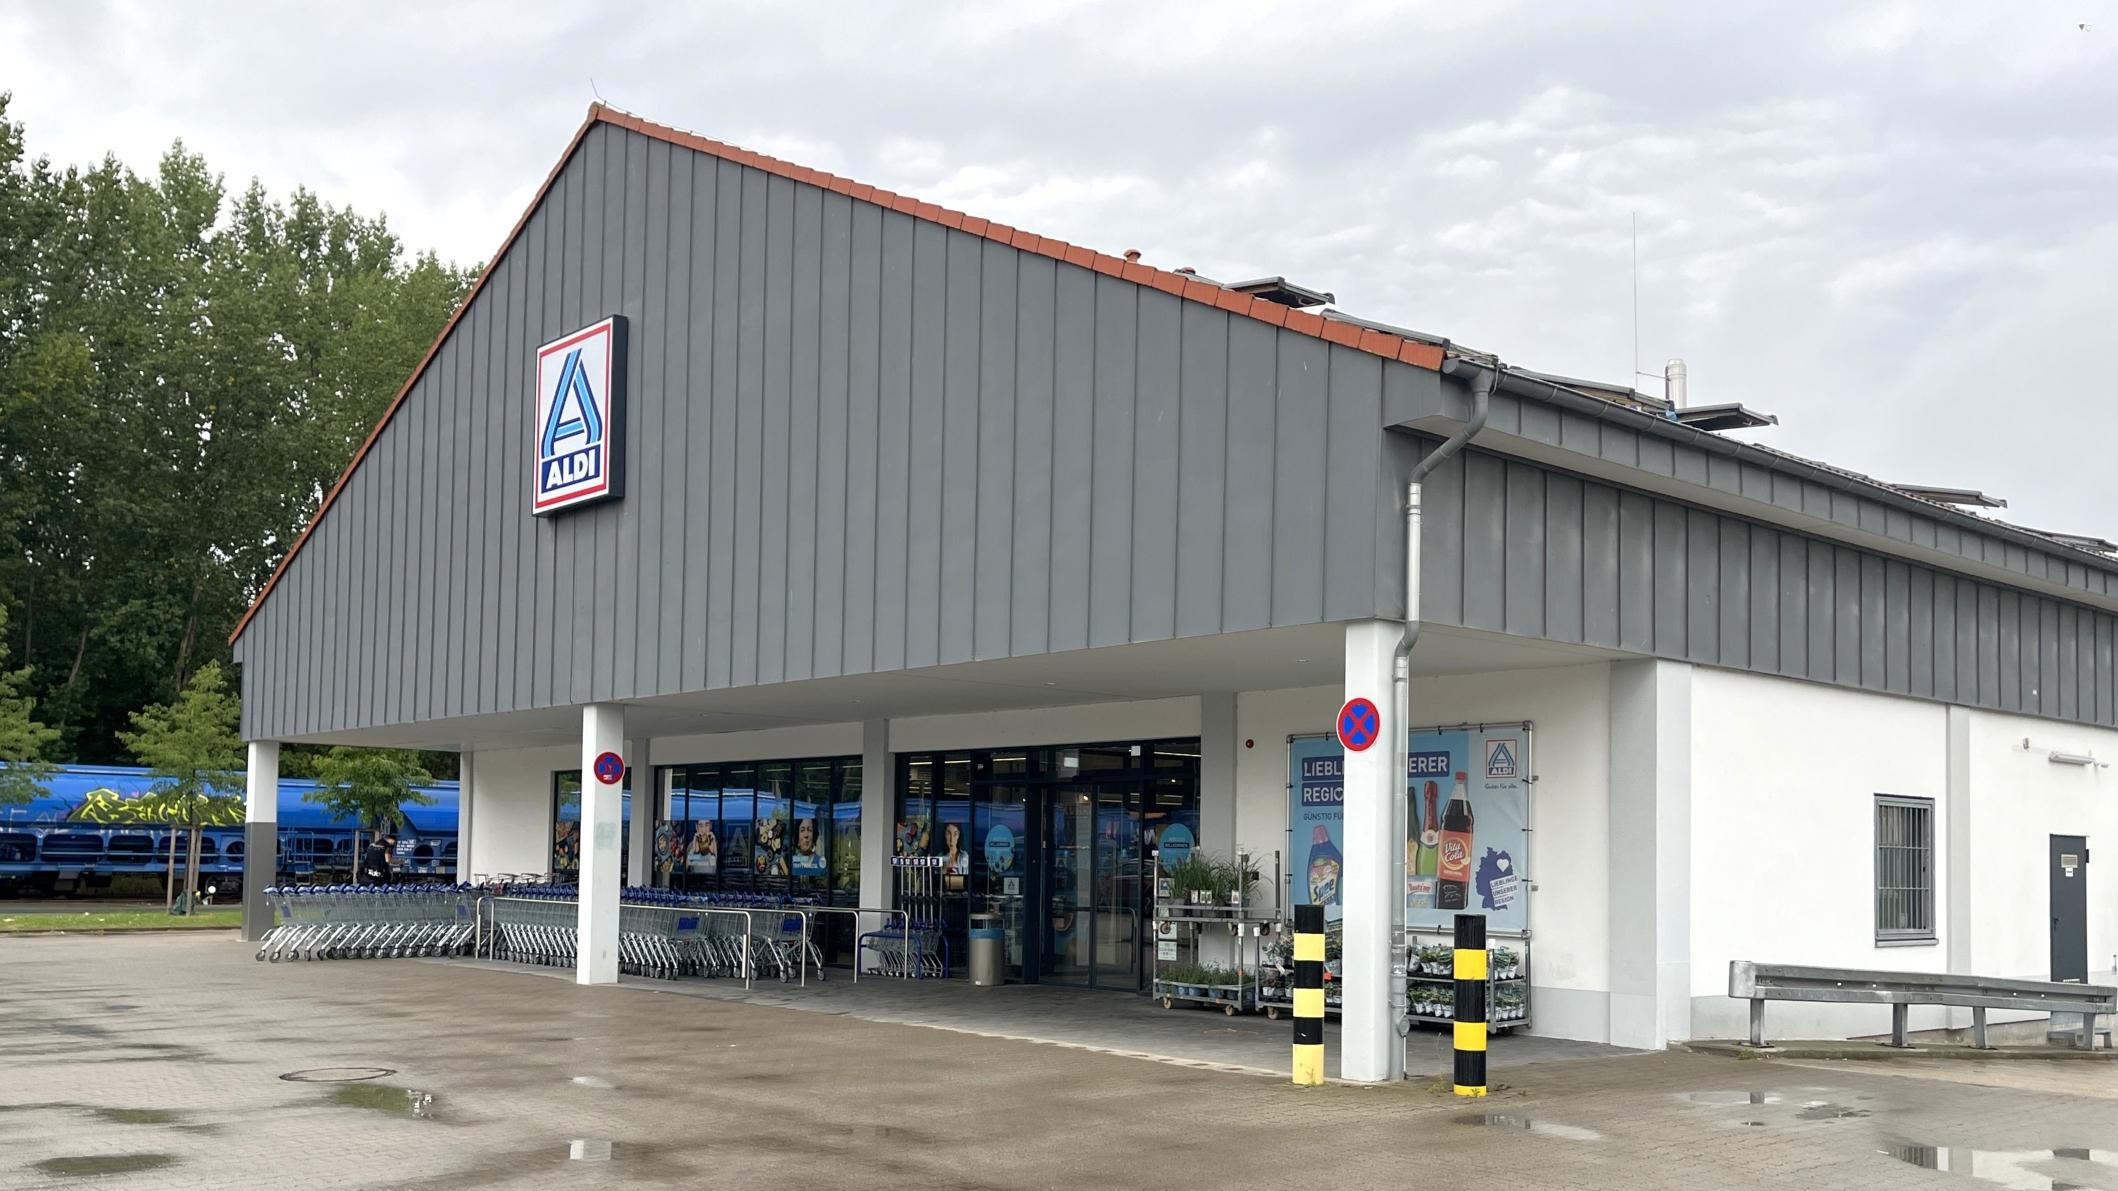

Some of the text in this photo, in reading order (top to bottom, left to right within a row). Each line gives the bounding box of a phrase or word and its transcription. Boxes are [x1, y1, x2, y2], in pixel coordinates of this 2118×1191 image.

[545, 448, 596, 490] ALDI
[1303, 756, 1448, 777] LIEBLI ERER
[1491, 767, 1512, 775] ALDI
[1303, 787, 1345, 802] REGIO
[1313, 879, 1335, 903] Spee
